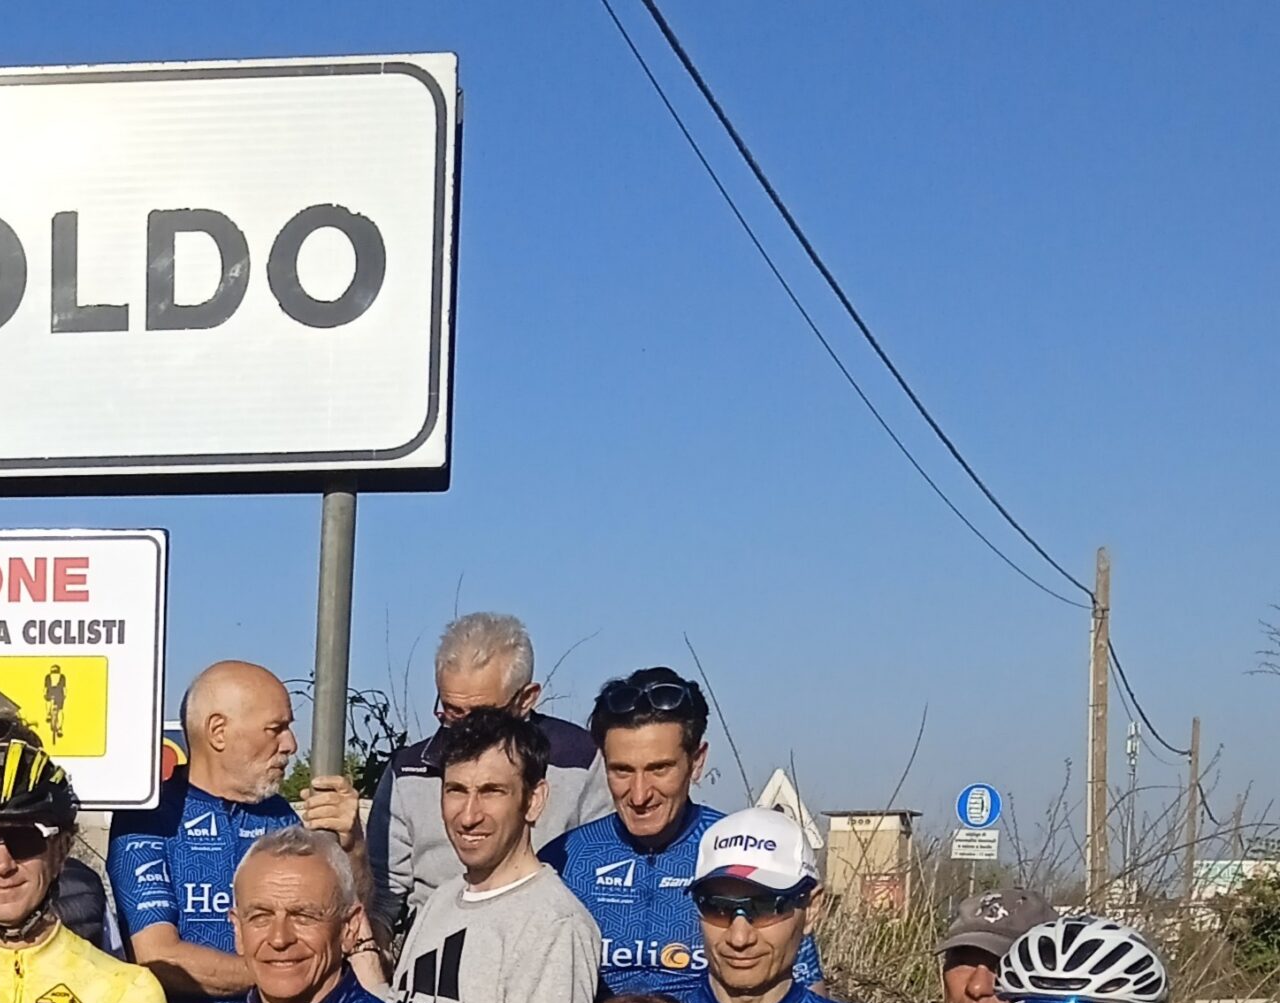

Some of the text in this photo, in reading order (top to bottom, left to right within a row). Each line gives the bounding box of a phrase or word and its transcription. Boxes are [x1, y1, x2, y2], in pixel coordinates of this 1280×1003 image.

[22, 620, 126, 645] CICLISTI
[187, 828, 210, 837] ADR
[713, 834, 777, 851] lampre
[137, 873, 163, 883] ADR
[596, 876, 622, 886] ADR
